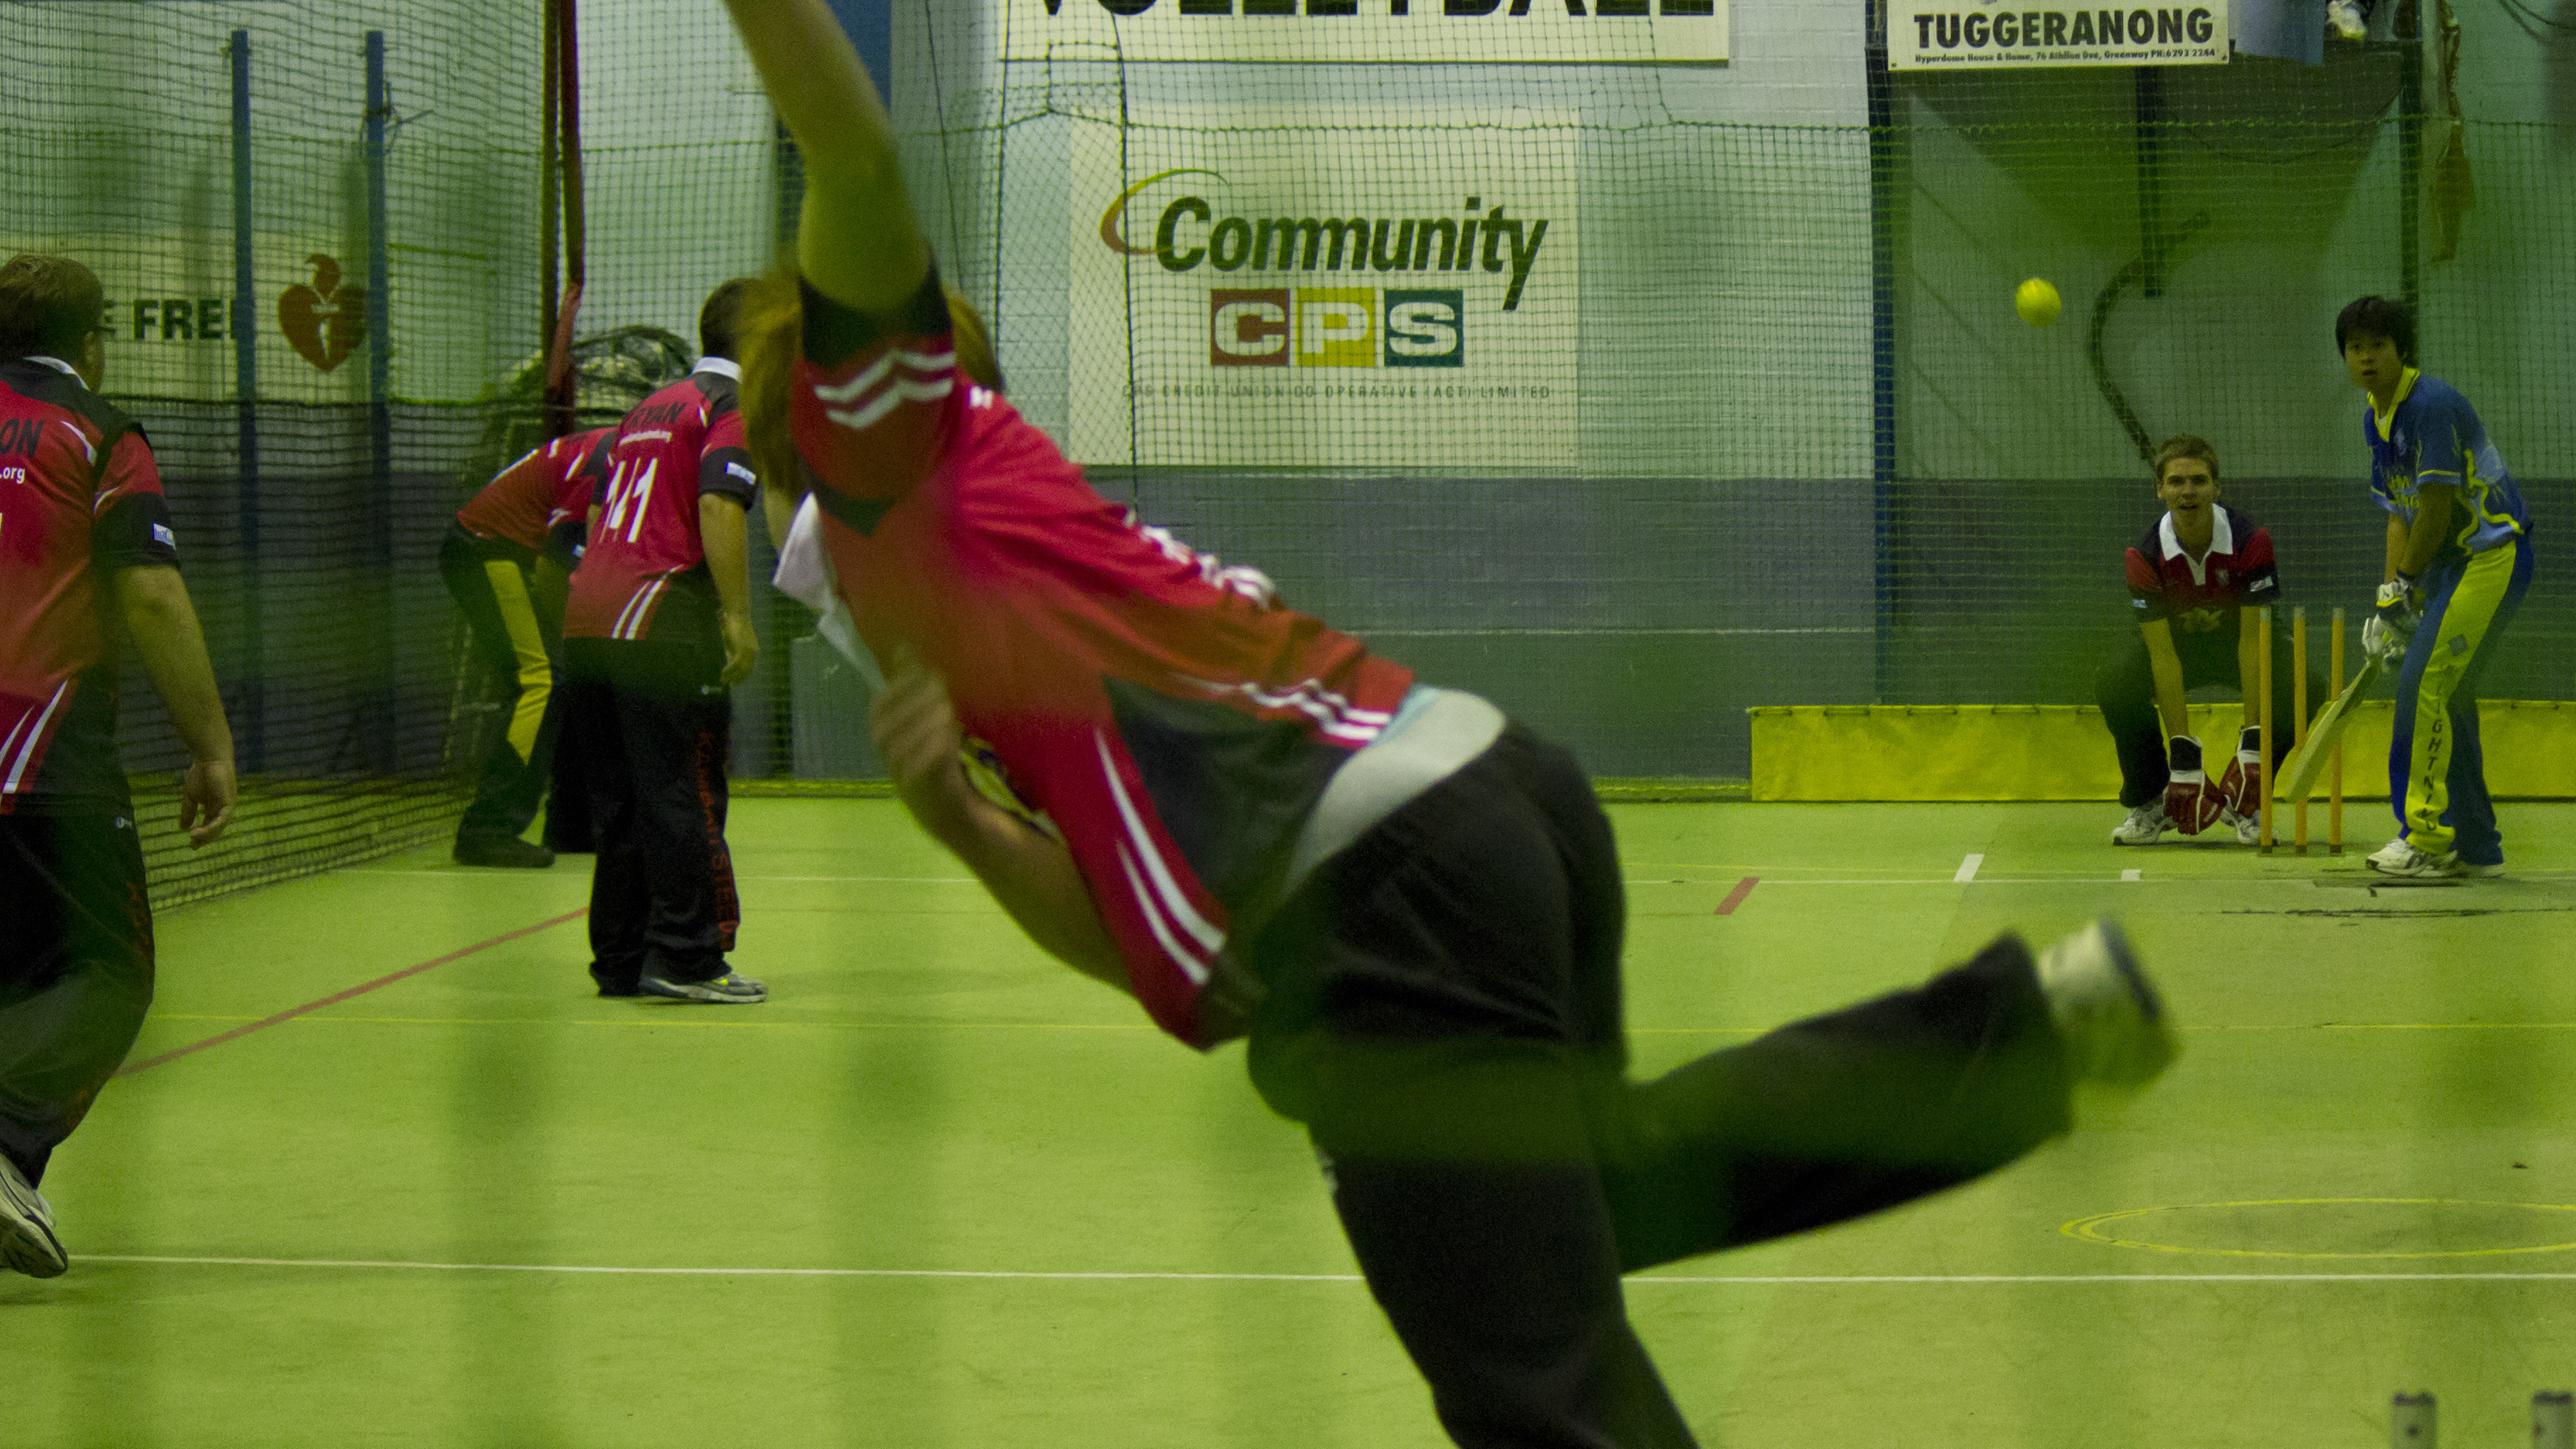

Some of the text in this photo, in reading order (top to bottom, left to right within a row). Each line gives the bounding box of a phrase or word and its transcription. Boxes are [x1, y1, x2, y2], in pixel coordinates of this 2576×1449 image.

[1913, 8, 2214, 49] TUGGERANONG
[1915, 53, 1966, 64] Hyperdome
[1968, 53, 1994, 62] House
[1996, 52, 2003, 62] &
[2104, 50, 2149, 59] Greenway
[1155, 196, 1549, 311] Community
[132, 299, 242, 340] FRE
[1214, 302, 1458, 356] CPS
[1161, 384, 1220, 397] CREDIT
[1230, 385, 1284, 398] UNION
[1481, 385, 1550, 398] LIMITED
